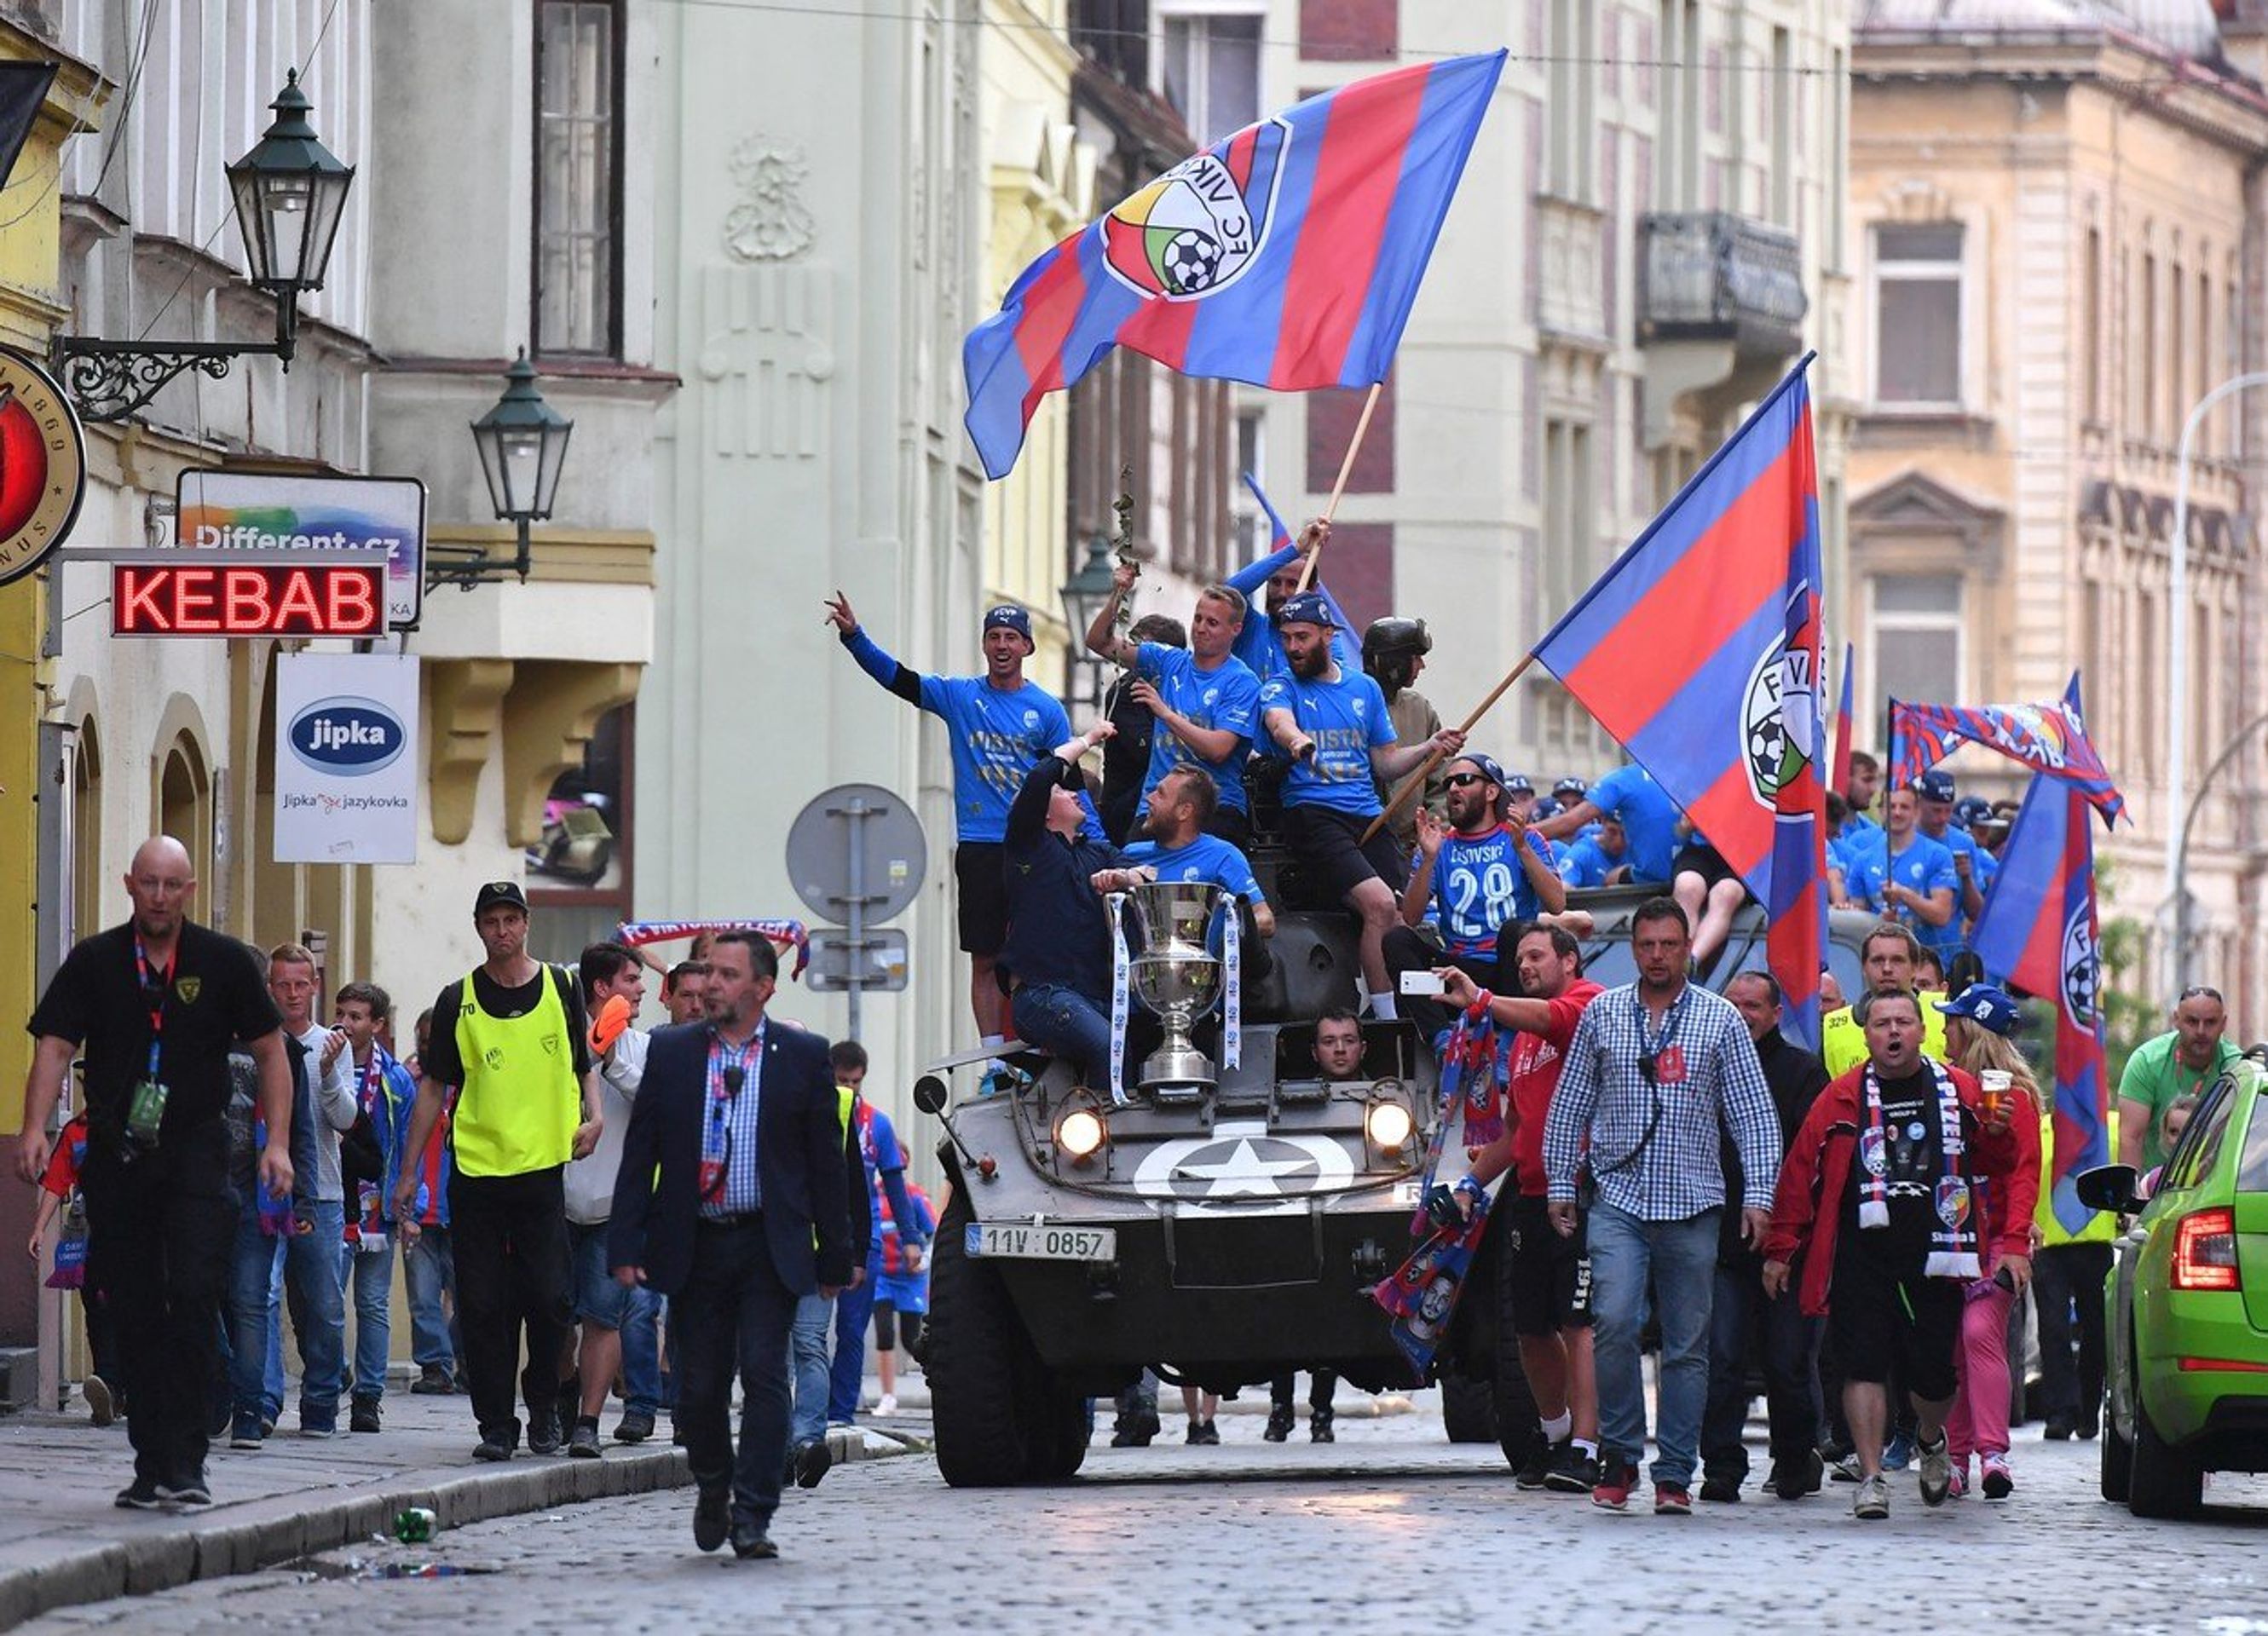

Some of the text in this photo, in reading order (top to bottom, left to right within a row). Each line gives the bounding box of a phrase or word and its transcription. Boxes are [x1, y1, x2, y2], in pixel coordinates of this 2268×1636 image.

[0, 521, 47, 565] NUS
[124, 571, 374, 630] KEBAB
[390, 602, 412, 616] KA
[309, 718, 385, 750] jipka
[283, 793, 408, 810] Jipka jazykovka
[1449, 862, 1517, 936] 28
[1828, 1016, 1849, 1029] 329
[1936, 1082, 1966, 1155] PLZEŇ
[987, 1230, 1105, 1257] 11V 0857
